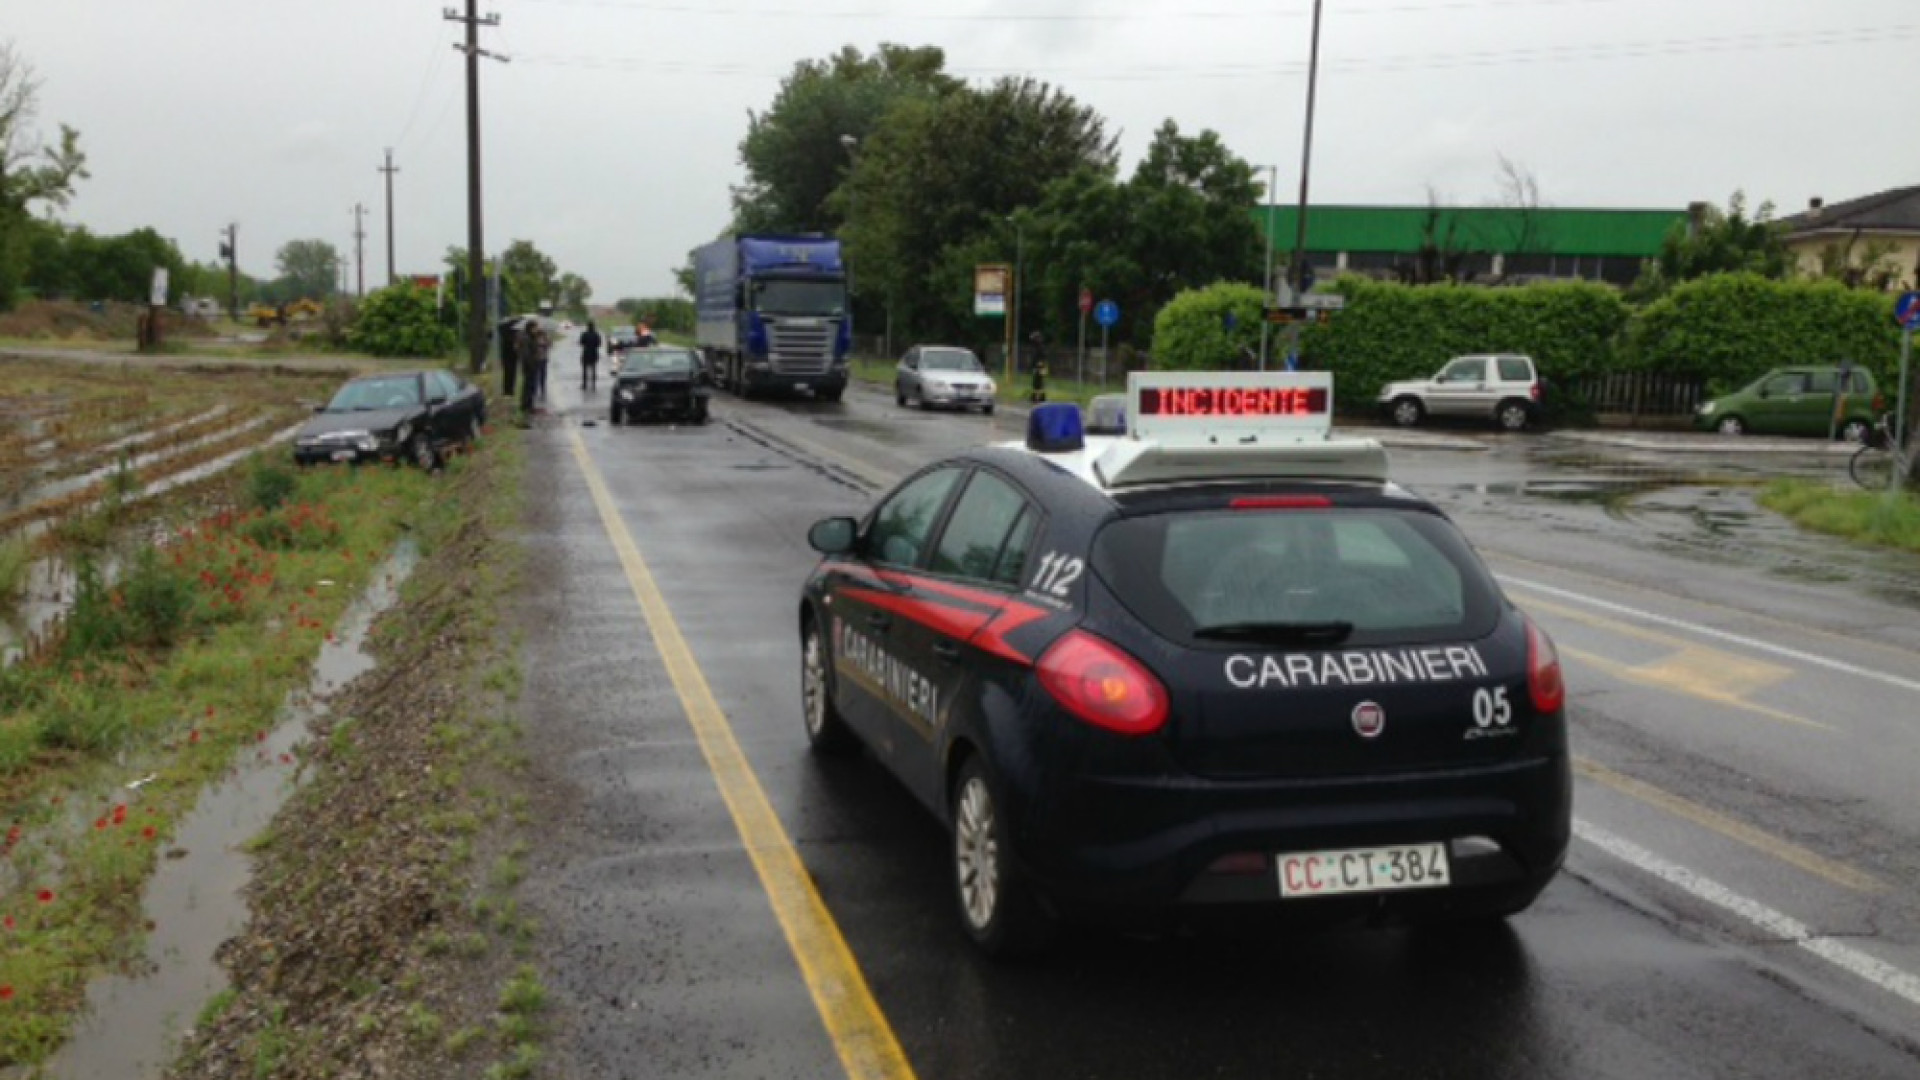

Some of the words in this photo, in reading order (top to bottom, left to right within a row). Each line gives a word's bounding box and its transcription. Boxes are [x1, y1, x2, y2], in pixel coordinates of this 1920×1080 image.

[1157, 386, 1312, 418] INCIDENTE
[1031, 550, 1084, 597] 112
[844, 622, 939, 727] CARABINIERI
[1224, 645, 1489, 688] CARABINIERI
[1472, 685, 1511, 728] 05
